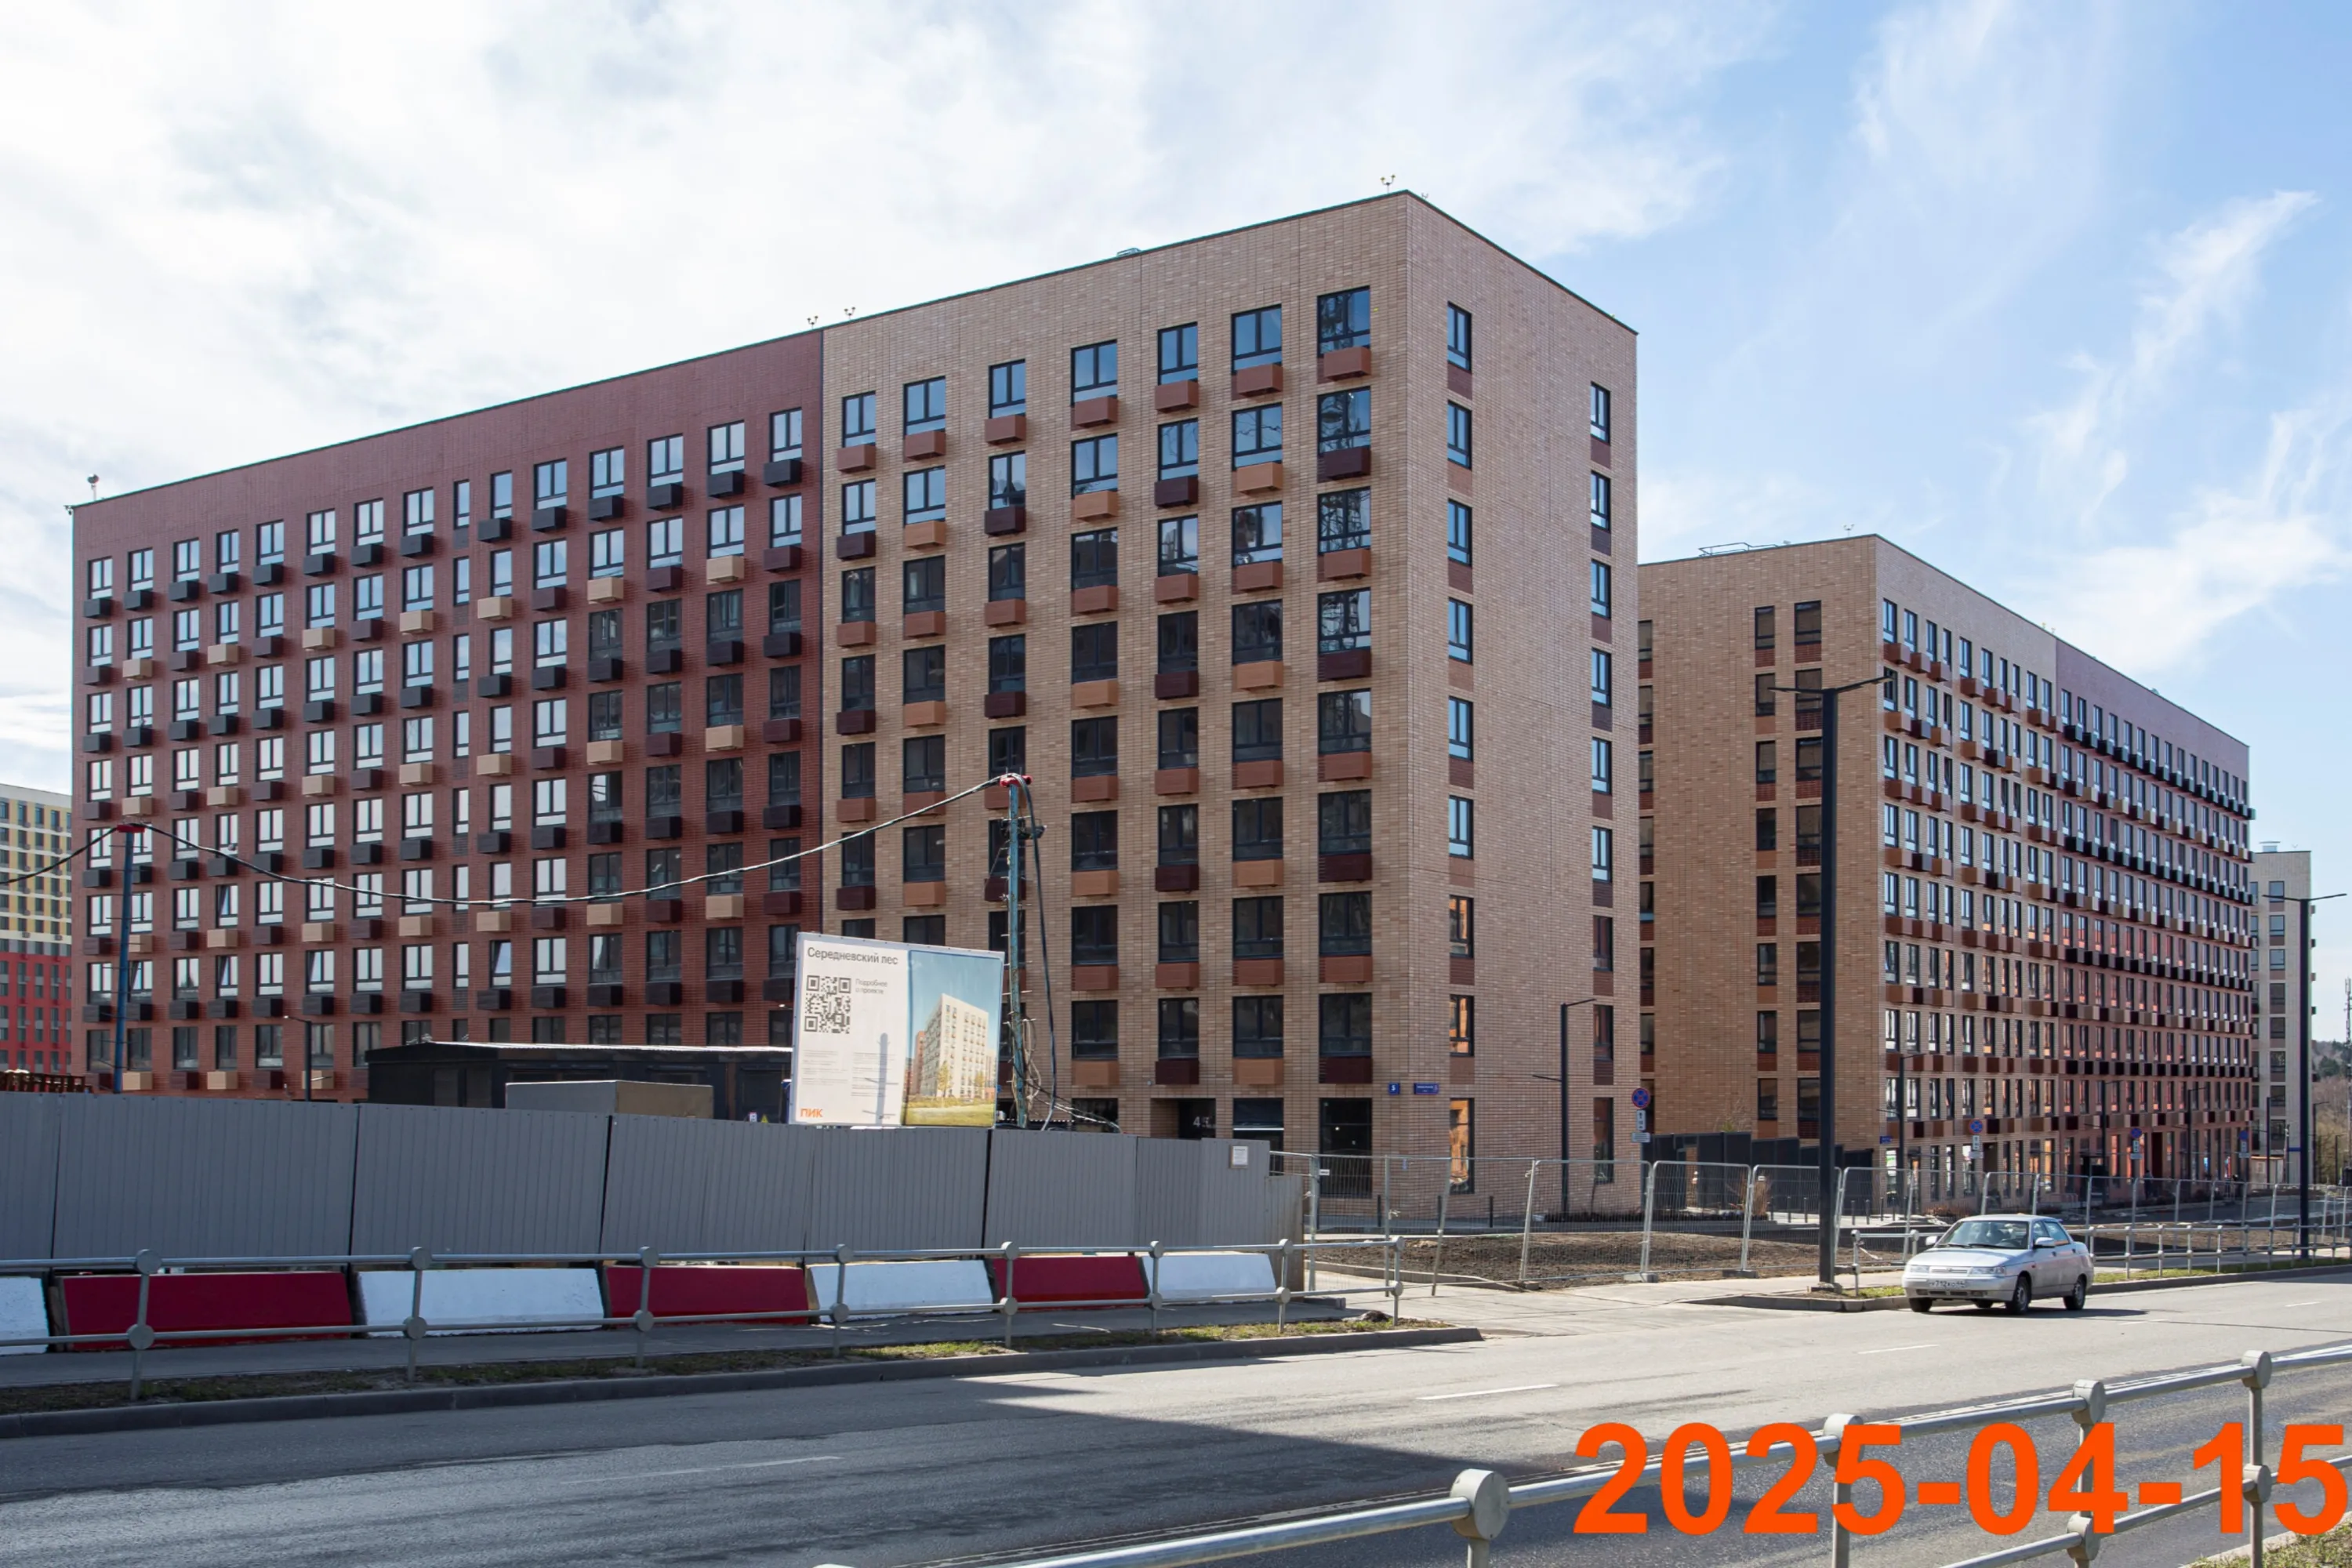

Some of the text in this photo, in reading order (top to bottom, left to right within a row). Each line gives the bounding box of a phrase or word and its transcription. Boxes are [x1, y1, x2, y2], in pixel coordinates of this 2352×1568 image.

[808, 947, 898, 965] Середневский лес
[855, 978, 888, 988] Подробнее
[800, 1108, 823, 1118] ПИК
